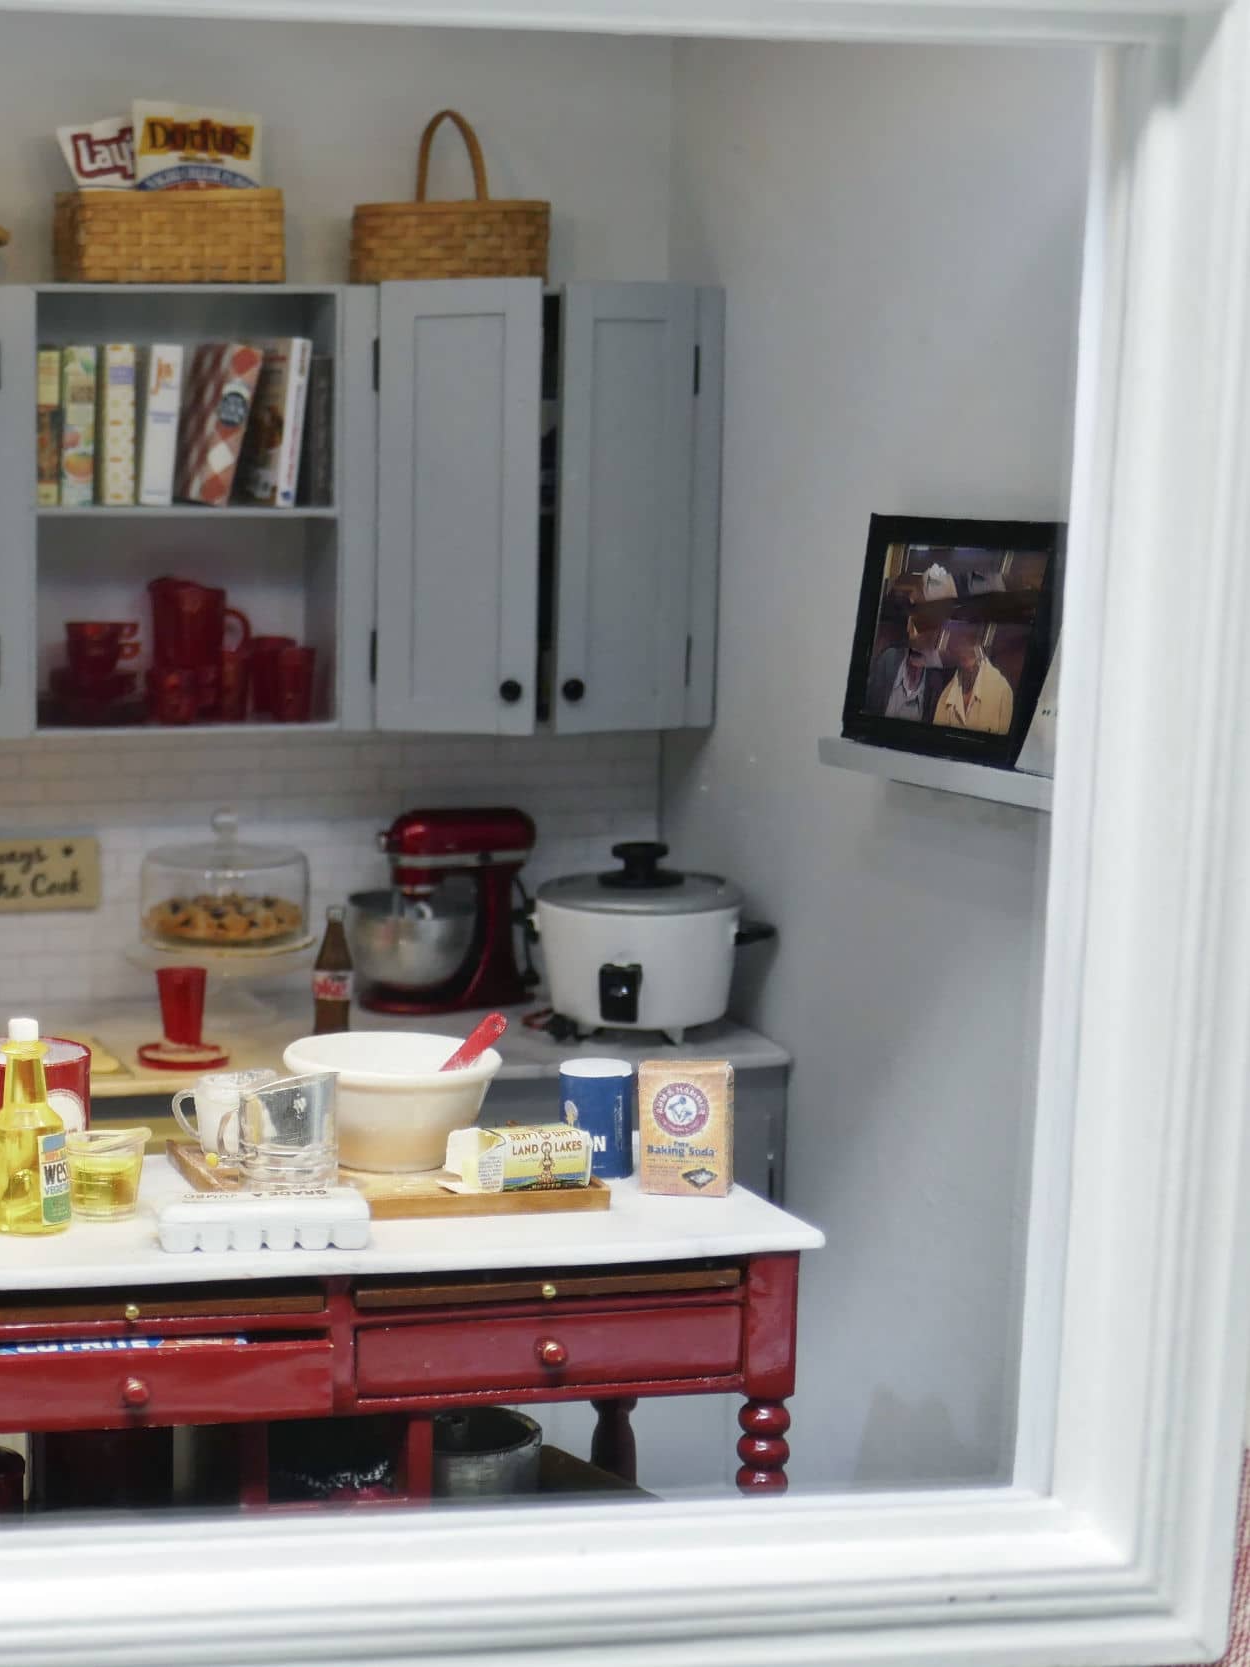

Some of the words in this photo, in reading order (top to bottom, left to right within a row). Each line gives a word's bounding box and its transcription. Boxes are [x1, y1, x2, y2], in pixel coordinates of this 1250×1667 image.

[148, 119, 251, 156] Doritos
[30, 868, 80, 898] Cook
[512, 1142, 539, 1156] LAND
[554, 1139, 583, 1152] LAKES
[646, 1144, 686, 1158] Baking
[689, 1145, 715, 1157] Soda
